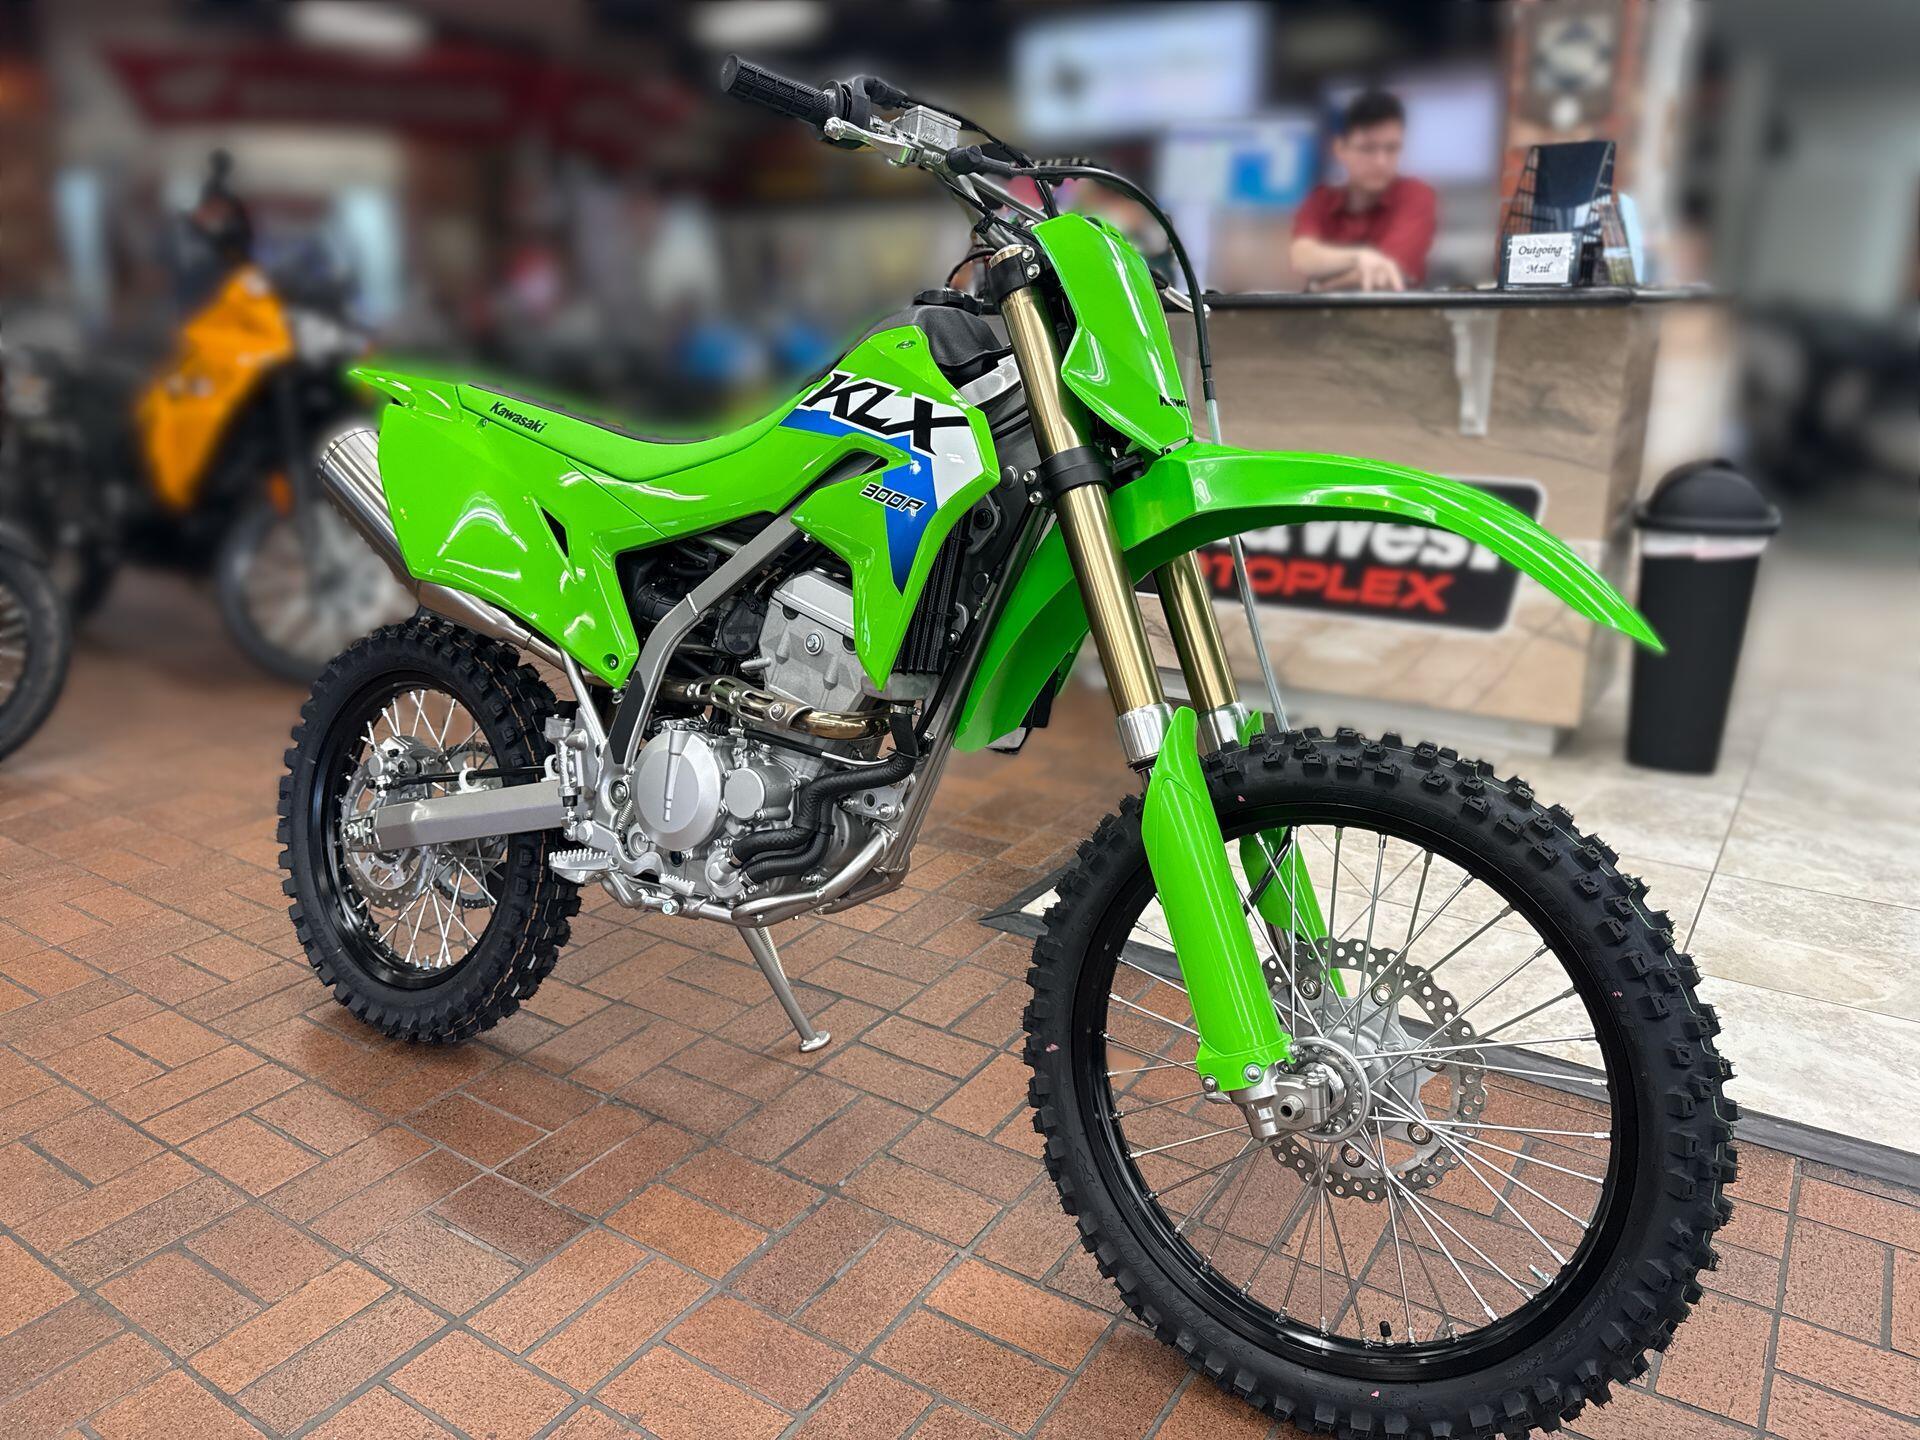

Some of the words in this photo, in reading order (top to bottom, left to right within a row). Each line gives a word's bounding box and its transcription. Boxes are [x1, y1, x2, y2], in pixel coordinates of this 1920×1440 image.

[1518, 244, 1563, 258] Outgoing
[489, 401, 548, 433] Kawasaki
[800, 371, 971, 456] KLX
[859, 482, 927, 515] 300R
